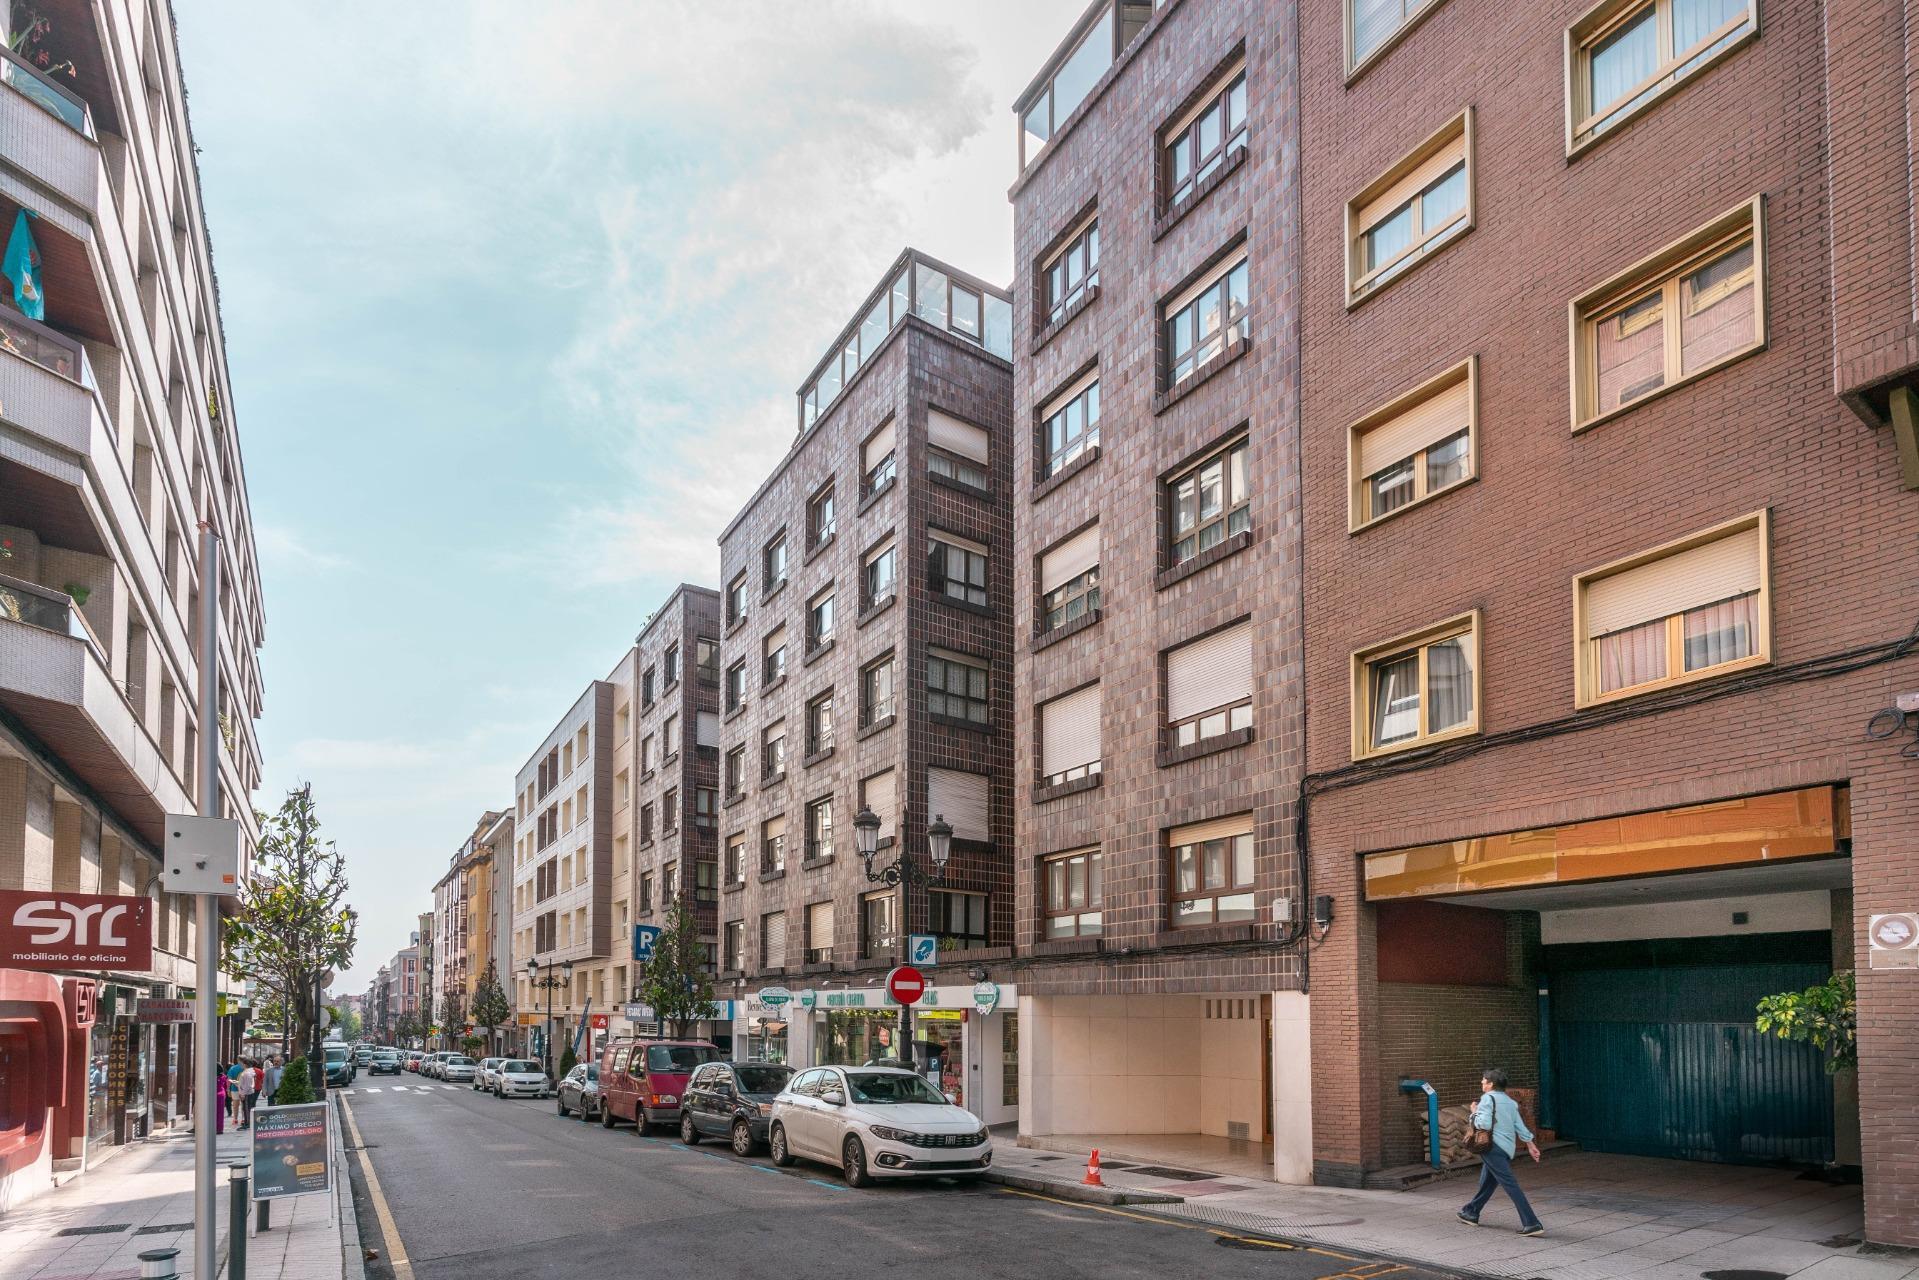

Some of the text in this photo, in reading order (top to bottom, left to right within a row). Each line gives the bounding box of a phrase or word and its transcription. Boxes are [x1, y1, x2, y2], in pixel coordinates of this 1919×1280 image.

[13, 900, 127, 947] SYC
[640, 931, 654, 950] P
[13, 953, 126, 962] mobiliario de oficina
[117, 1025, 126, 1106] COLCHONES
[931, 1058, 938, 1069] P
[257, 1123, 290, 1131] MÁXIMO
[293, 1120, 322, 1129] PRECIO
[945, 1135, 957, 1145] FIAT
